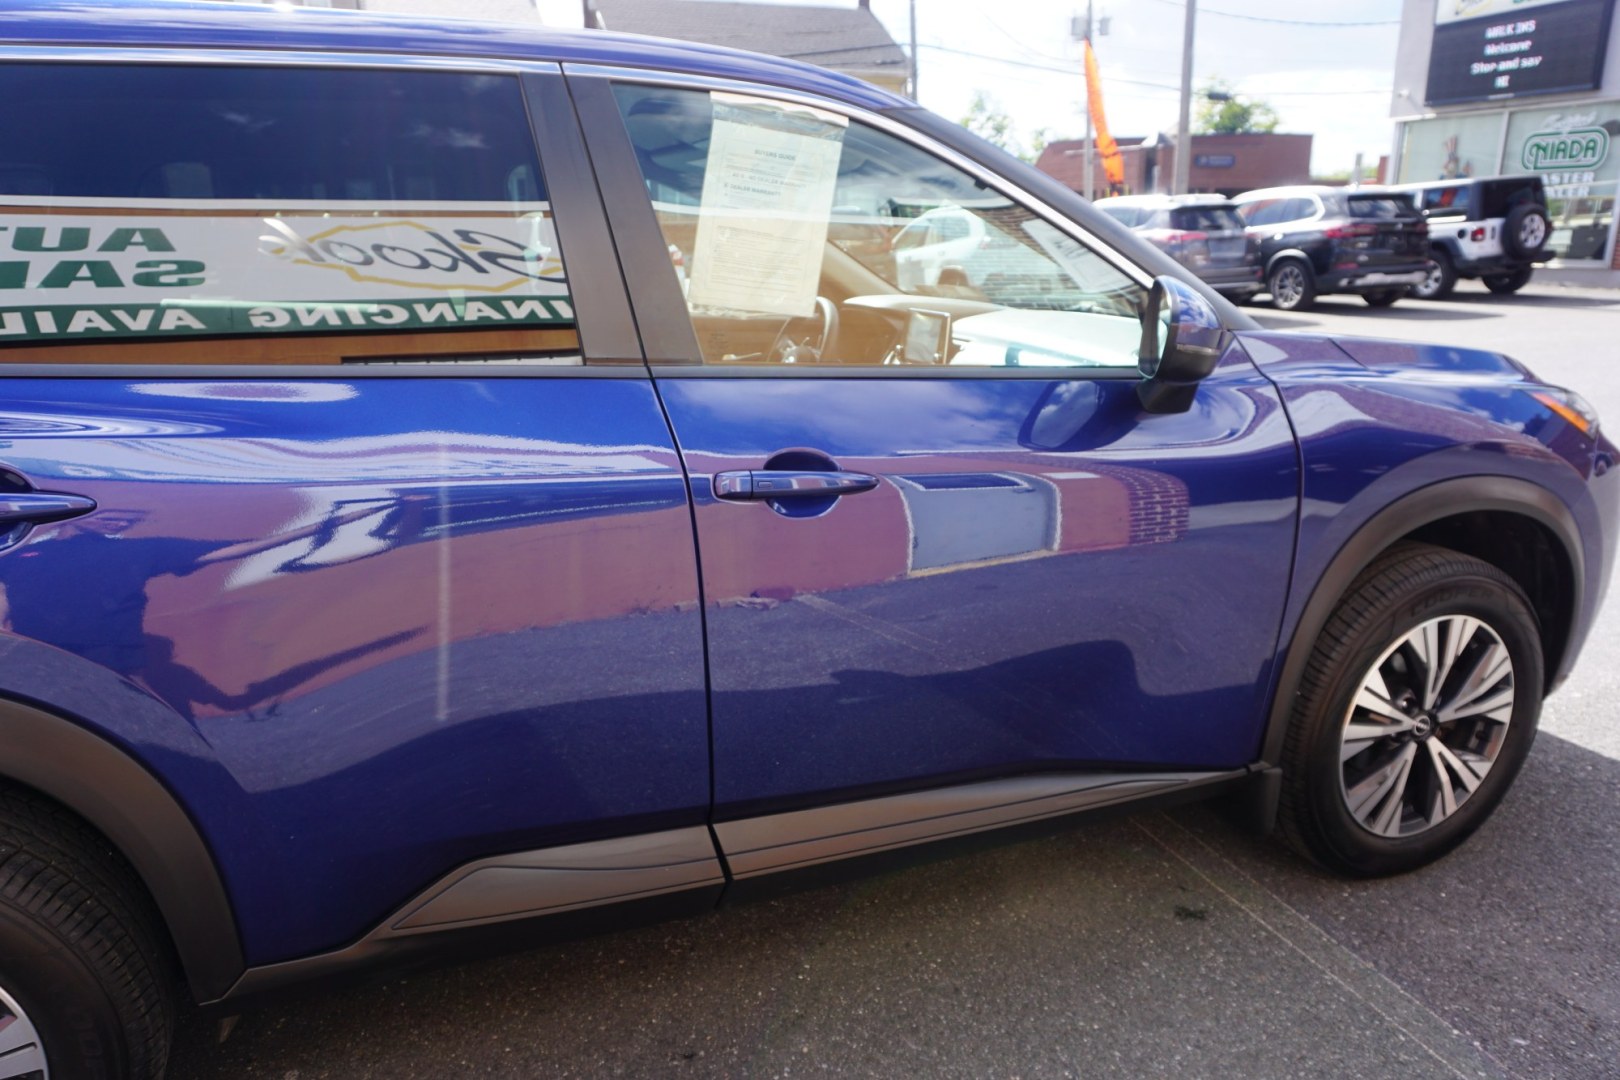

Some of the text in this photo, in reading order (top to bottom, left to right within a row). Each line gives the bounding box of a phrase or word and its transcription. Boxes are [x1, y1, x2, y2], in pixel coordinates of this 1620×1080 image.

[1485, 41, 1531, 55] Welcome
[1471, 62, 1496, 74] Stop
[1498, 58, 1519, 71] and
[754, 150, 796, 161] BUYERS GUIDE
[1529, 138, 1598, 163] NIADA
[1542, 171, 1595, 186] ASTER
